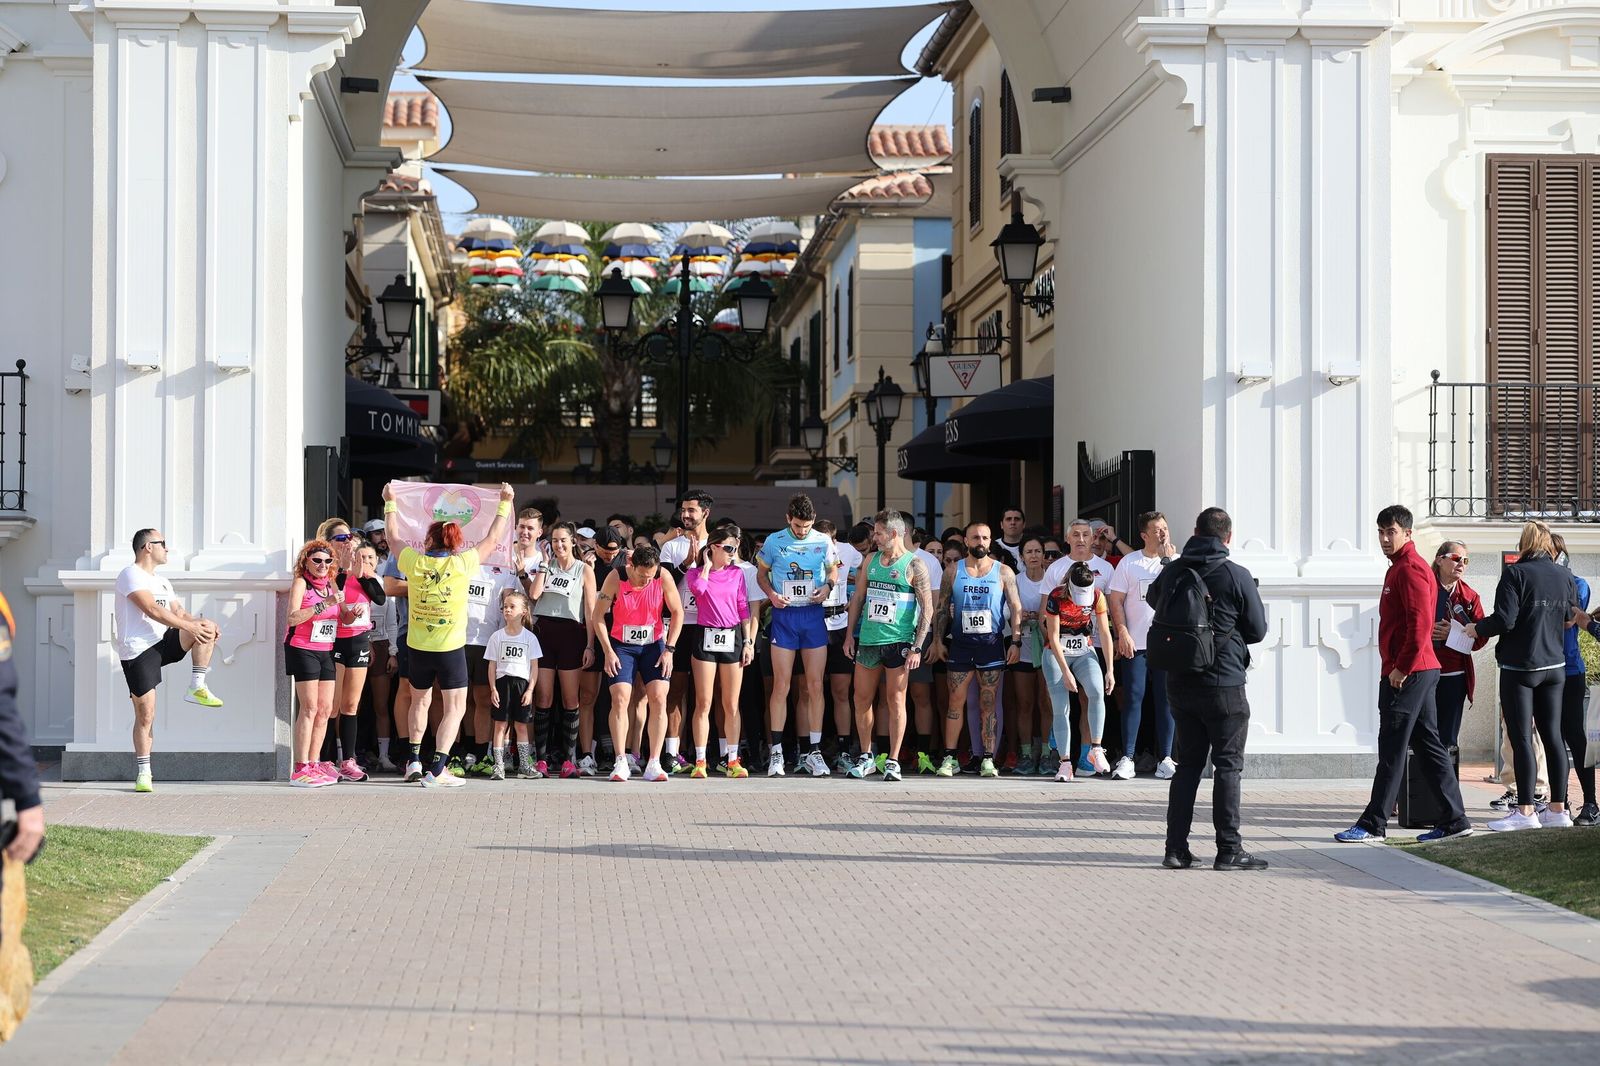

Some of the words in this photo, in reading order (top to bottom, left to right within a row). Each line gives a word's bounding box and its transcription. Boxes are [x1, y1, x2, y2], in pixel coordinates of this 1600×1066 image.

[953, 362, 976, 370] GUESS
[475, 461, 496, 469] Guest
[497, 461, 525, 469] Services
[551, 577, 569, 588] 408
[869, 581, 897, 591] ATLETISMO
[468, 585, 485, 596] 501
[792, 585, 806, 596] 161
[963, 585, 990, 594] ERESO
[874, 604, 889, 615] 179
[969, 616, 985, 627] 169
[630, 629, 648, 640] 240
[714, 634, 726, 645] 84
[1066, 638, 1082, 649] 425
[505, 646, 524, 658] 503
